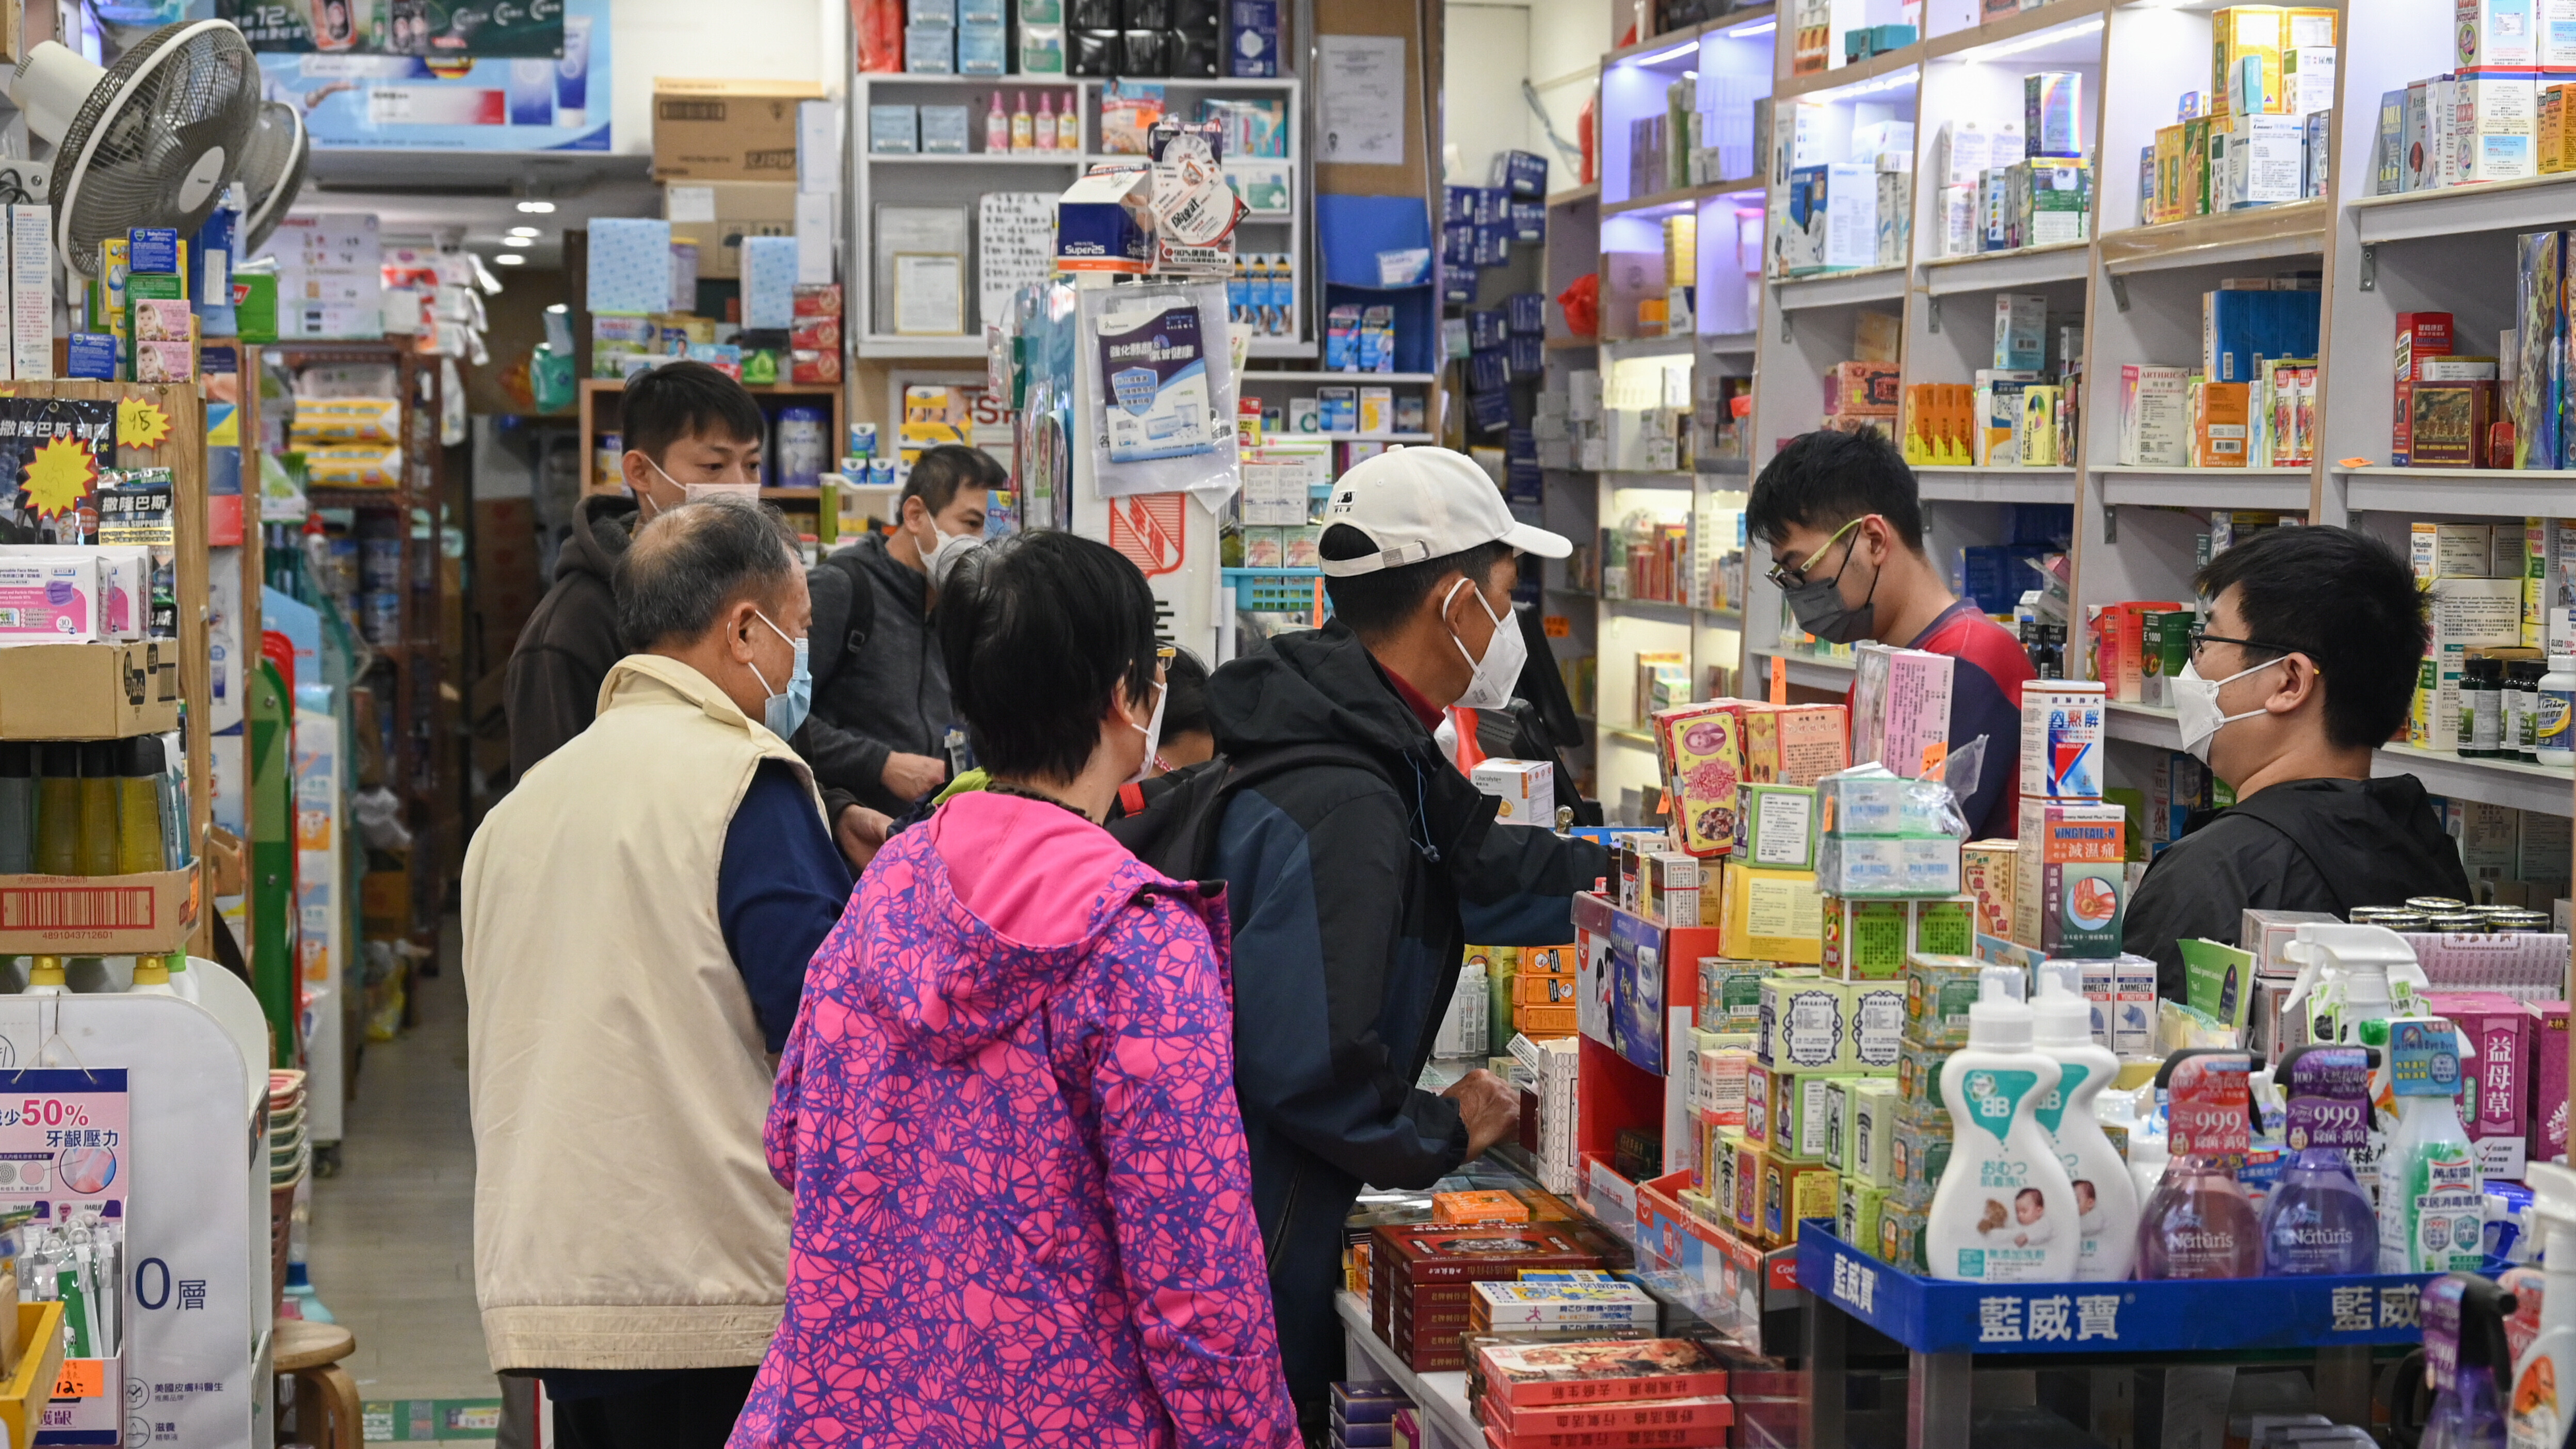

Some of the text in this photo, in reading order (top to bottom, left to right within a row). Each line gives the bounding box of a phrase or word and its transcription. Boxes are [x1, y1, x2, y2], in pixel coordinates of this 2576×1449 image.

[1065, 245, 1105, 255] Super25
[0, 420, 71, 438] 撒隆巴斯
[102, 495, 167, 512] 撒隆巴斯
[2148, 632, 2161, 642] 1000
[2551, 639, 2563, 648] GLUCO
[42, 931, 113, 940] 4891043712601
[2082, 984, 2108, 992] MMELTZ
[2119, 984, 2151, 992] AMMELTZ
[2485, 1036, 2511, 1118] 益母草
[2196, 1111, 2242, 1135] 999
[2314, 1105, 2360, 1130] 999
[46, 1129, 118, 1148] 牙齦壓力
[1982, 1161, 2027, 1176] おむつ
[1833, 1252, 1874, 1314] 藍威寶
[2332, 1283, 2421, 1331] 藍威
[1978, 1293, 2119, 1342] 藍威寶
[154, 1383, 223, 1393] 美國皮膚科醫生
[155, 1422, 175, 1432] 滋養
